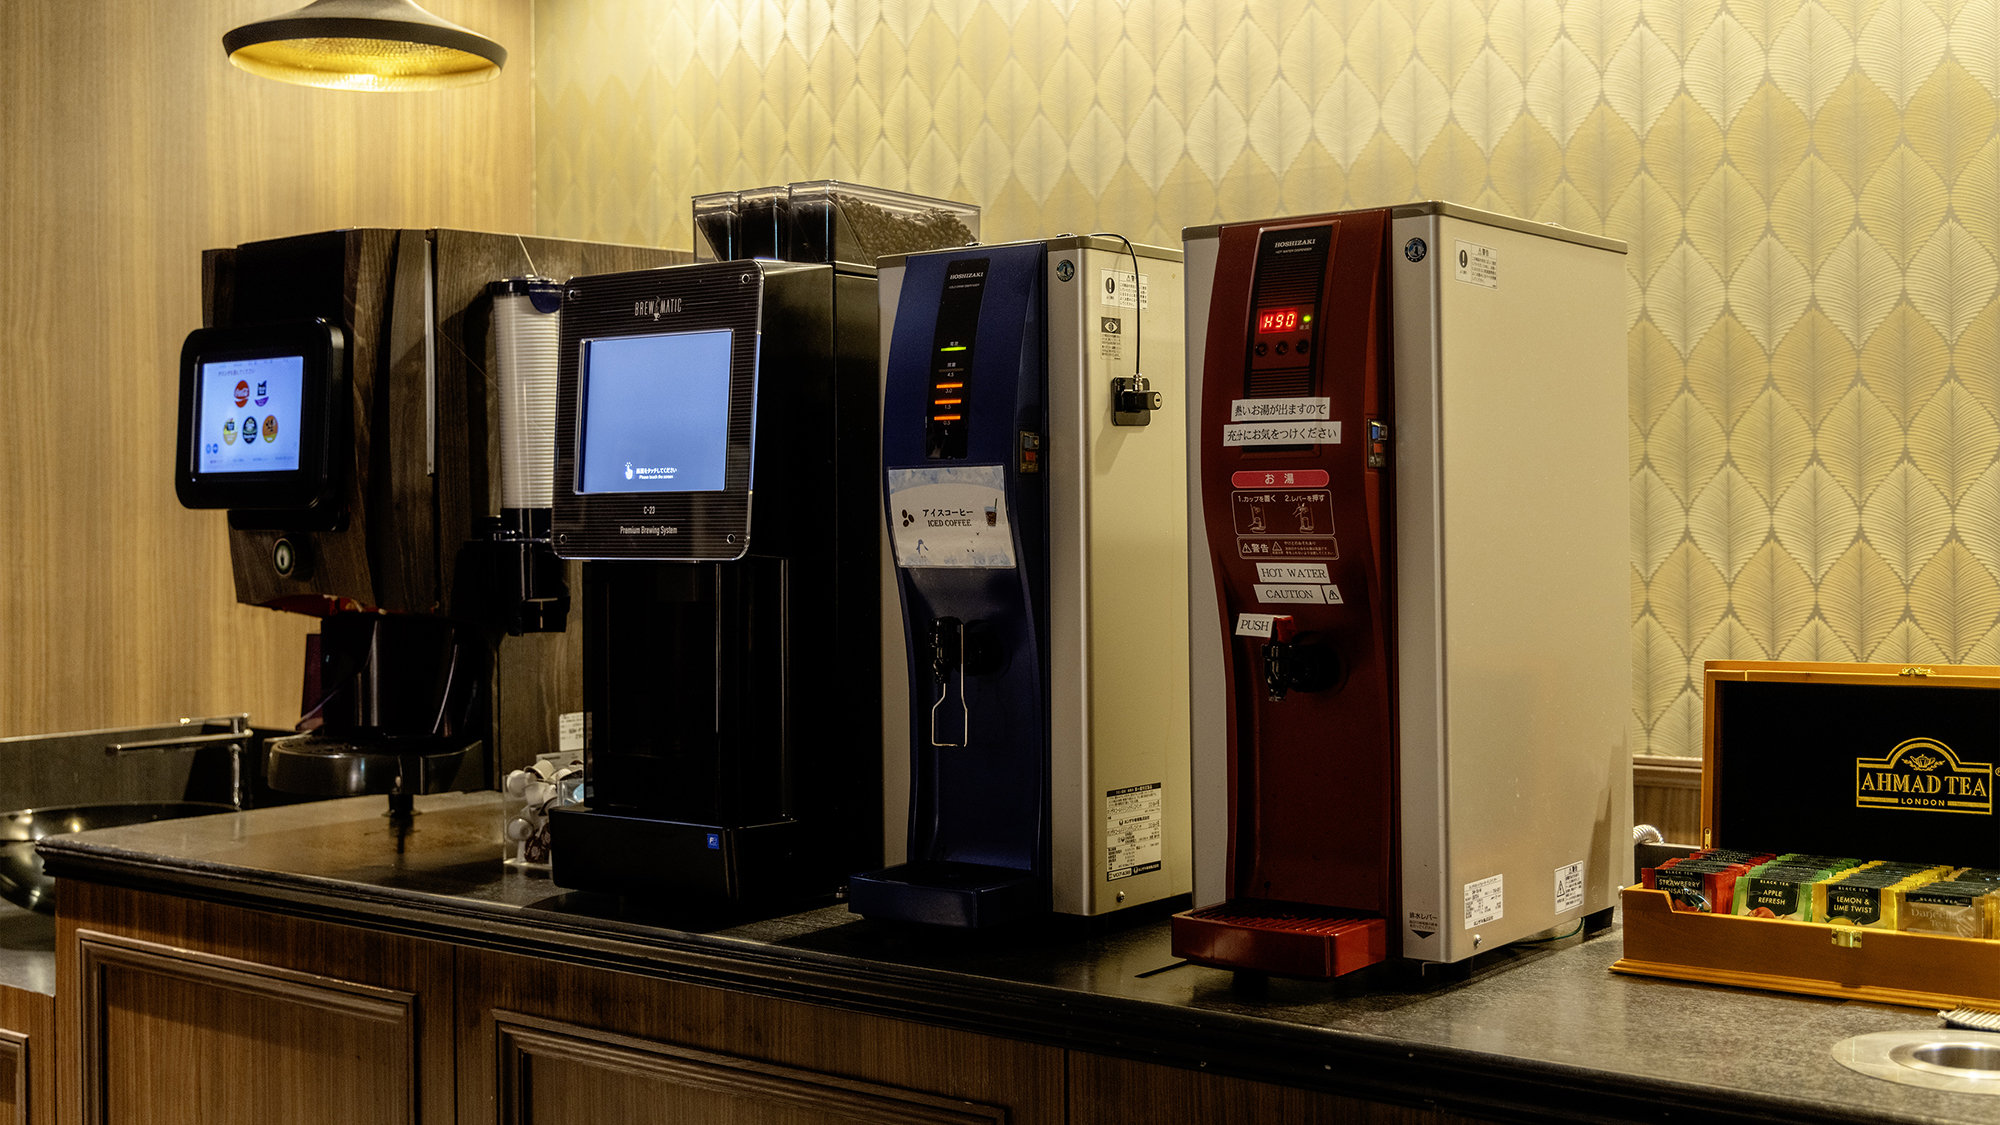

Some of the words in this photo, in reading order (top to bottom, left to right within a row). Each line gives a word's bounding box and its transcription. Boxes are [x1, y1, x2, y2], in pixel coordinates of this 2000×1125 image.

[1274, 238, 1316, 248] HOSHIZAKI
[949, 271, 984, 280] HOSHIZAKI
[1234, 403, 1327, 417] 熱いお湯が出ますので
[1227, 427, 1337, 442] 充分にお気をつけください
[643, 505, 656, 515] C-23
[922, 508, 974, 518] アイスコーヒー
[927, 519, 944, 528] ICED
[944, 518, 972, 527] COFFEE
[619, 525, 640, 535] Premium
[641, 525, 660, 537] Brewing
[660, 525, 678, 537] System
[1260, 568, 1283, 578] HOT
[1286, 568, 1327, 579] WATER
[1265, 588, 1314, 599] CAUTION
[1239, 619, 1270, 632] PUSH
[1860, 772, 1942, 794] AHMAD
[1944, 775, 1988, 797] TEA
[1901, 797, 1945, 807] LONDON
[1658, 878, 1702, 889] STRAWBERRY
[1762, 889, 1783, 898] APPLE
[1757, 896, 1786, 906] REFRESH
[1836, 896, 1862, 905] LEMON
[1833, 904, 1849, 912] LIME
[1850, 905, 1873, 914] TWIST
[1929, 919, 1947, 928] Tea
